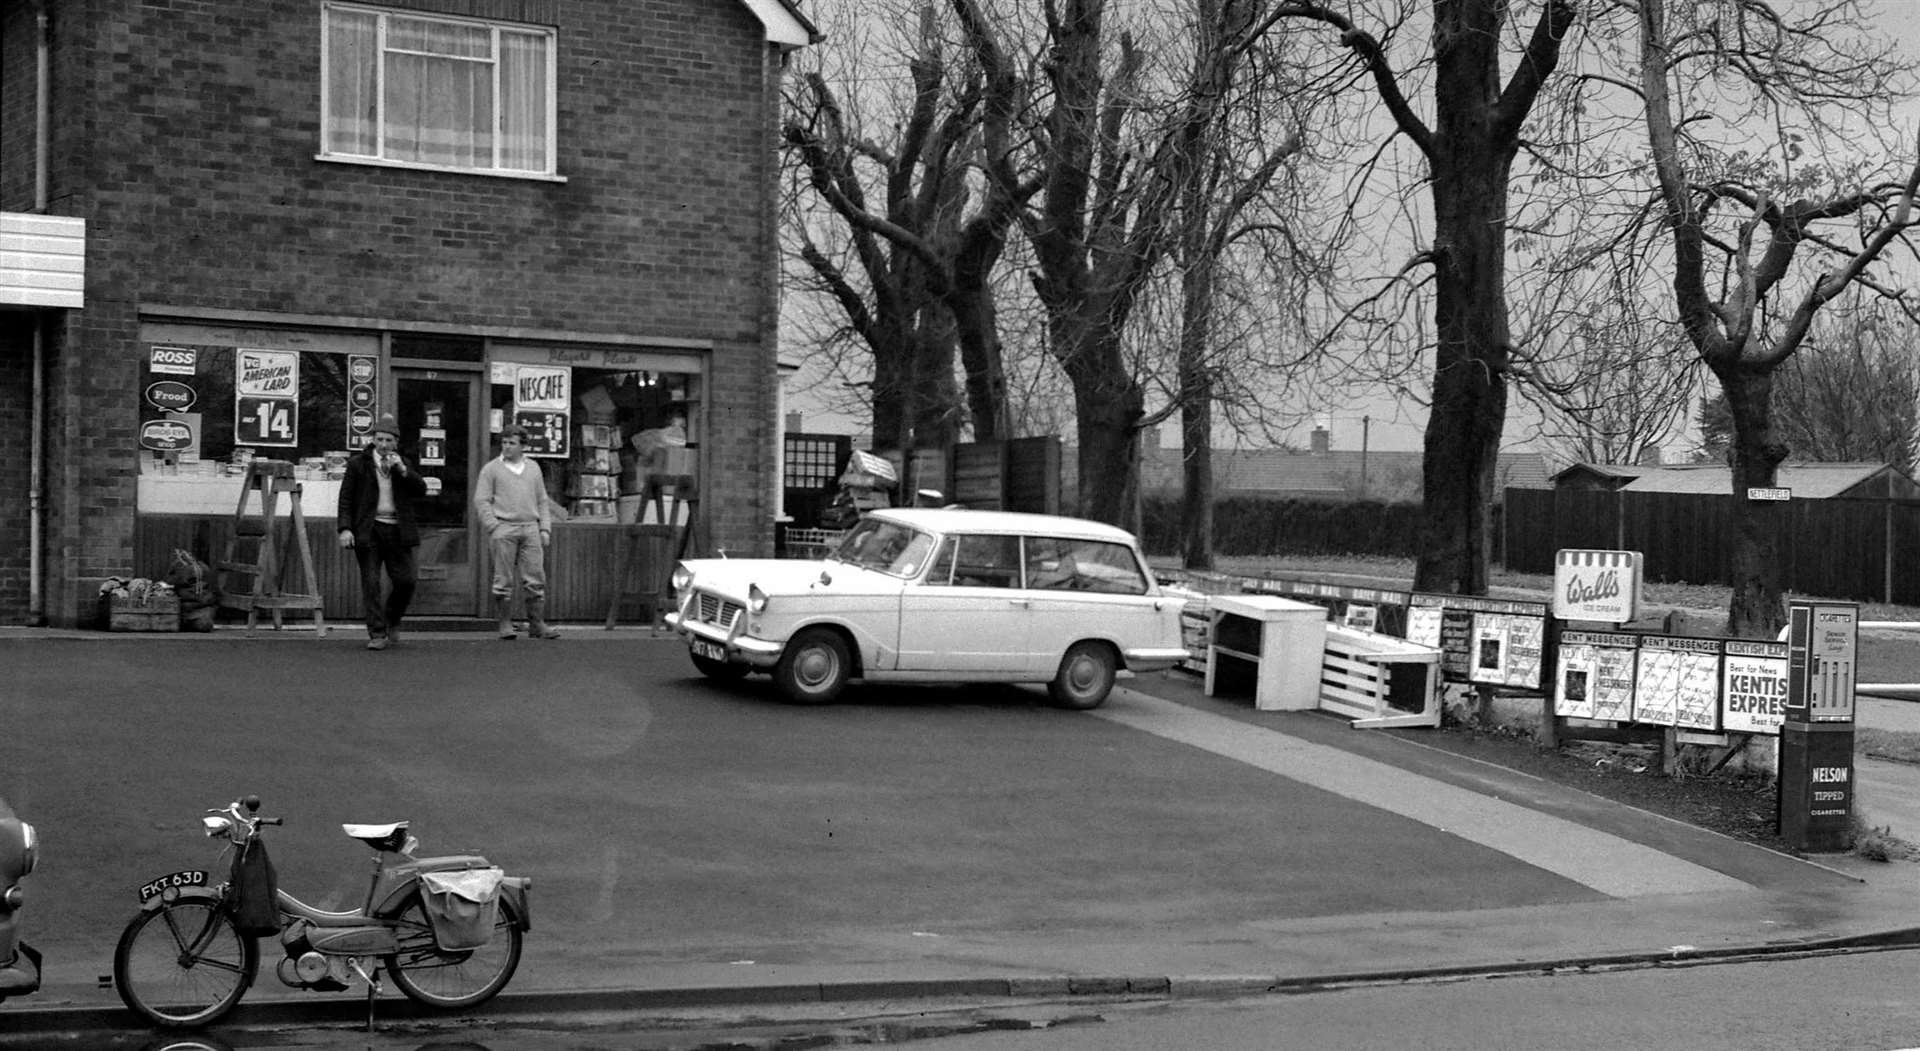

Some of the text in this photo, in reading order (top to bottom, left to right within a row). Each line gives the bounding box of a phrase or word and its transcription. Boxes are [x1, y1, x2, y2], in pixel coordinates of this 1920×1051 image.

[153, 350, 195, 364] ROSS
[242, 366, 291, 384] AMERICAN
[263, 377, 290, 391] LARD
[154, 390, 188, 402] Frood
[1750, 489, 1788, 499] NETTLEFIELD
[1583, 605, 1622, 614] ICE CREAM
[1561, 633, 1637, 645] KENT MESSENGER
[1642, 637, 1720, 651] KENT MESSENGER
[1727, 642, 1788, 657] KENTISH EXP
[1730, 662, 1777, 675] Best for News
[1730, 674, 1787, 696] KENTIS
[1729, 694, 1786, 715] EXPRES
[1751, 715, 1768, 726] Best
[1812, 767, 1848, 783] NELSON
[1814, 790, 1845, 801] TIPPED
[1811, 808, 1846, 817] CIGARETTES
[141, 871, 203, 898] FKT 63D
